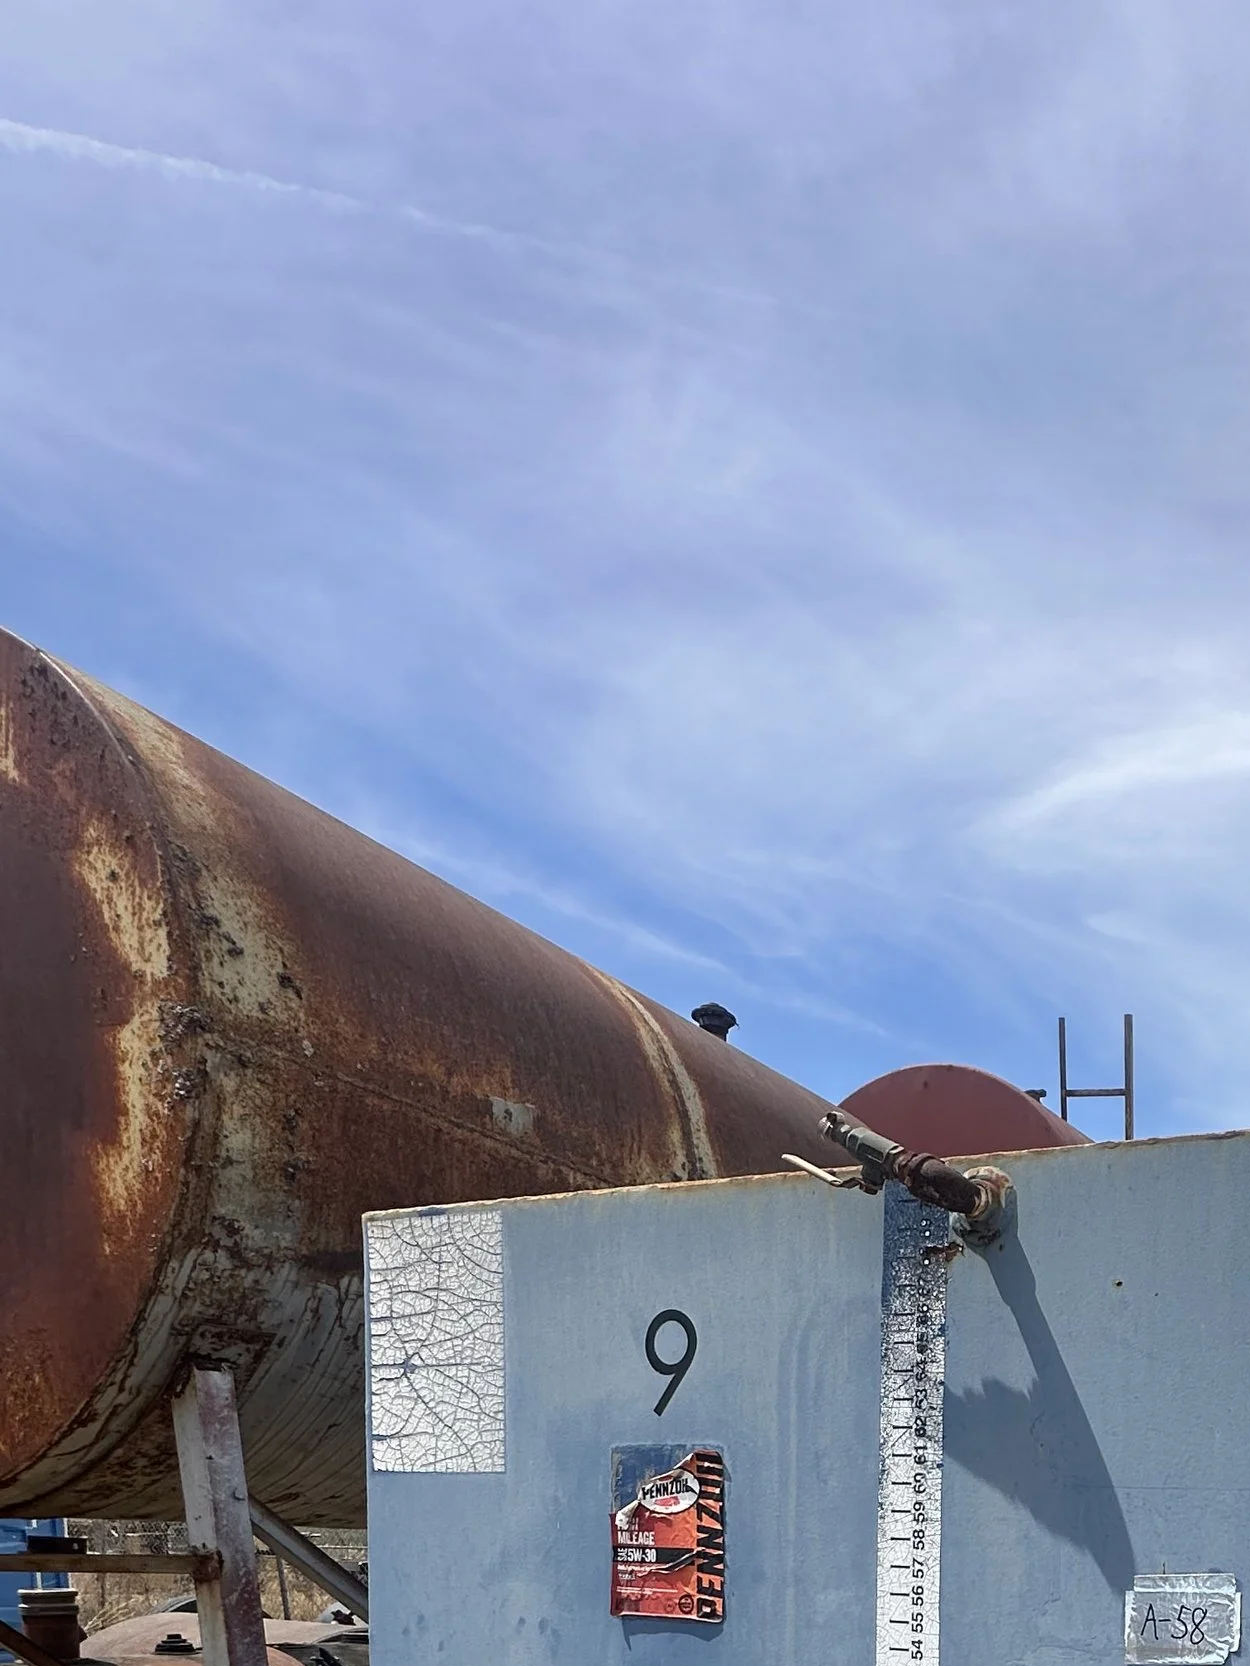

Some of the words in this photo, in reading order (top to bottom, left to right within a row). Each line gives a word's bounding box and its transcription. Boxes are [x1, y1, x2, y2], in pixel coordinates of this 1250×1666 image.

[645, 1309, 698, 1417] 9
[913, 1445, 928, 1465] 61
[912, 1501, 926, 1524] 59
[617, 1531, 656, 1546] MILEAGE
[911, 1528, 926, 1551] 58
[627, 1548, 657, 1563] 5W-30
[911, 1556, 925, 1580] 57
[911, 1585, 925, 1607] 56
[911, 1612, 924, 1634] 55
[1140, 1603, 1208, 1645] A-58
[910, 1639, 924, 1662] 54
